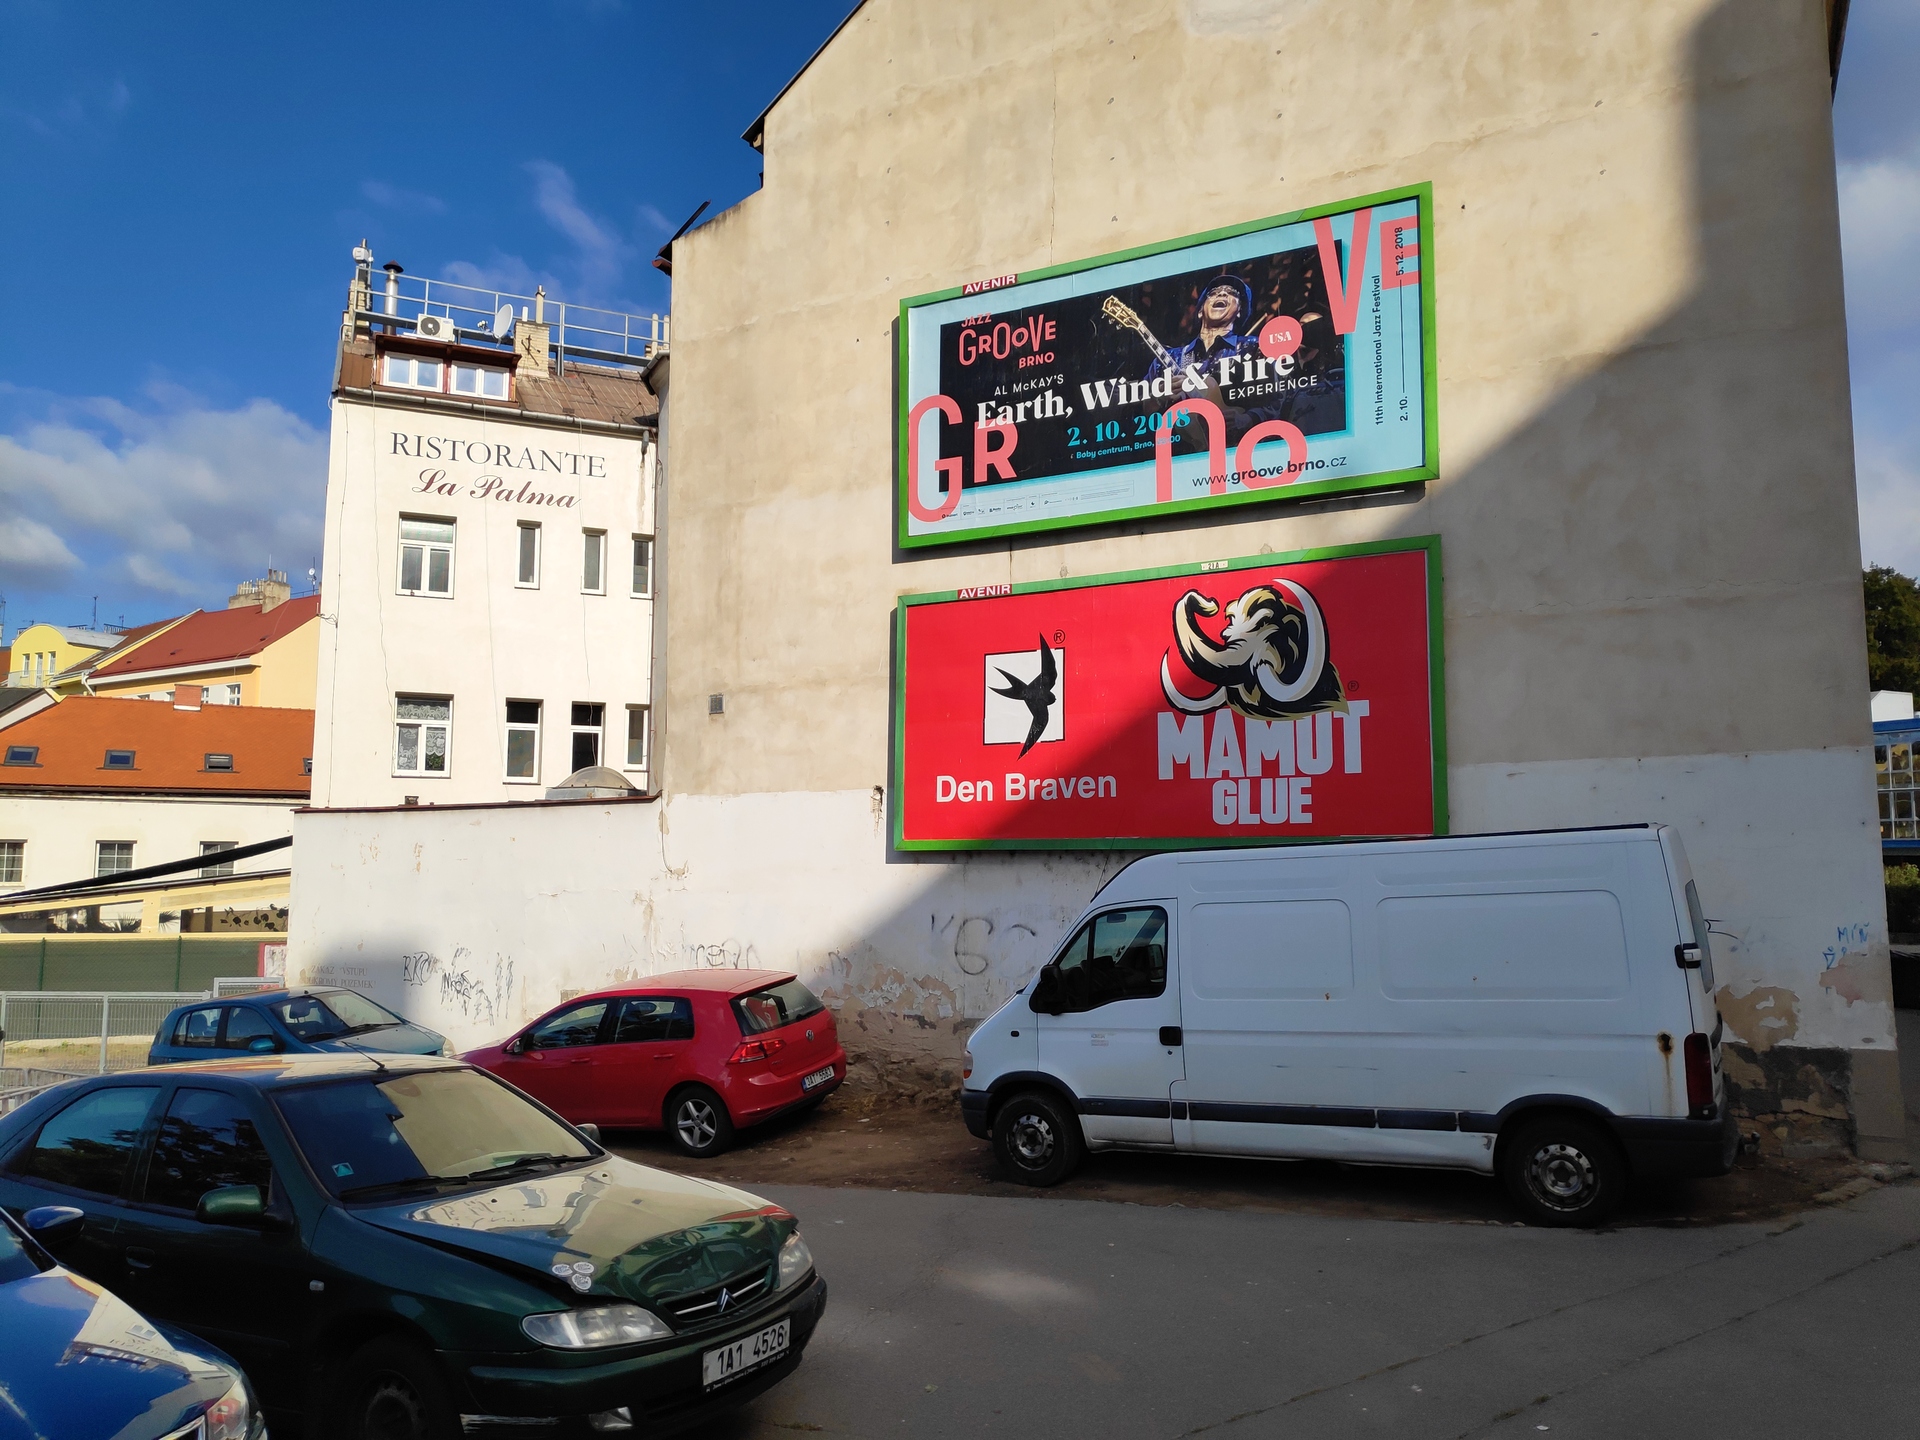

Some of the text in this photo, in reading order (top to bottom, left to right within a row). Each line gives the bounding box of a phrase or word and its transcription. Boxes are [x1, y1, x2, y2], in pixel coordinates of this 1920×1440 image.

[964, 274, 1016, 294] AVENIR
[961, 312, 992, 328] JAZZ
[1268, 330, 1293, 345] USA
[1394, 226, 1409, 422] 2. 10. 5. 12. 2018
[958, 314, 1057, 366] GROOVE
[1371, 274, 1384, 426] 11th International Jazz Festival
[1018, 351, 1055, 369] BRNO
[976, 352, 1296, 430] Earth, Wind & Fire
[994, 386, 1008, 396] AL
[1228, 374, 1319, 400] EXPERIENCE
[1066, 407, 1191, 447] 2. 10. 2018
[389, 431, 608, 479] RISTORANTE
[1097, 443, 1133, 457] centrum,
[1134, 440, 1155, 451] Brno,
[411, 467, 582, 509] La Palma
[959, 583, 1011, 599] AVENIR
[1157, 699, 1370, 780] MAMUT
[936, 772, 1118, 803] Den Braven
[1212, 776, 1313, 825] GLUE
[340, 966, 368, 977] VSTUPU
[717, 1343, 744, 1375] 1A1
[753, 1324, 785, 1358] 4526
